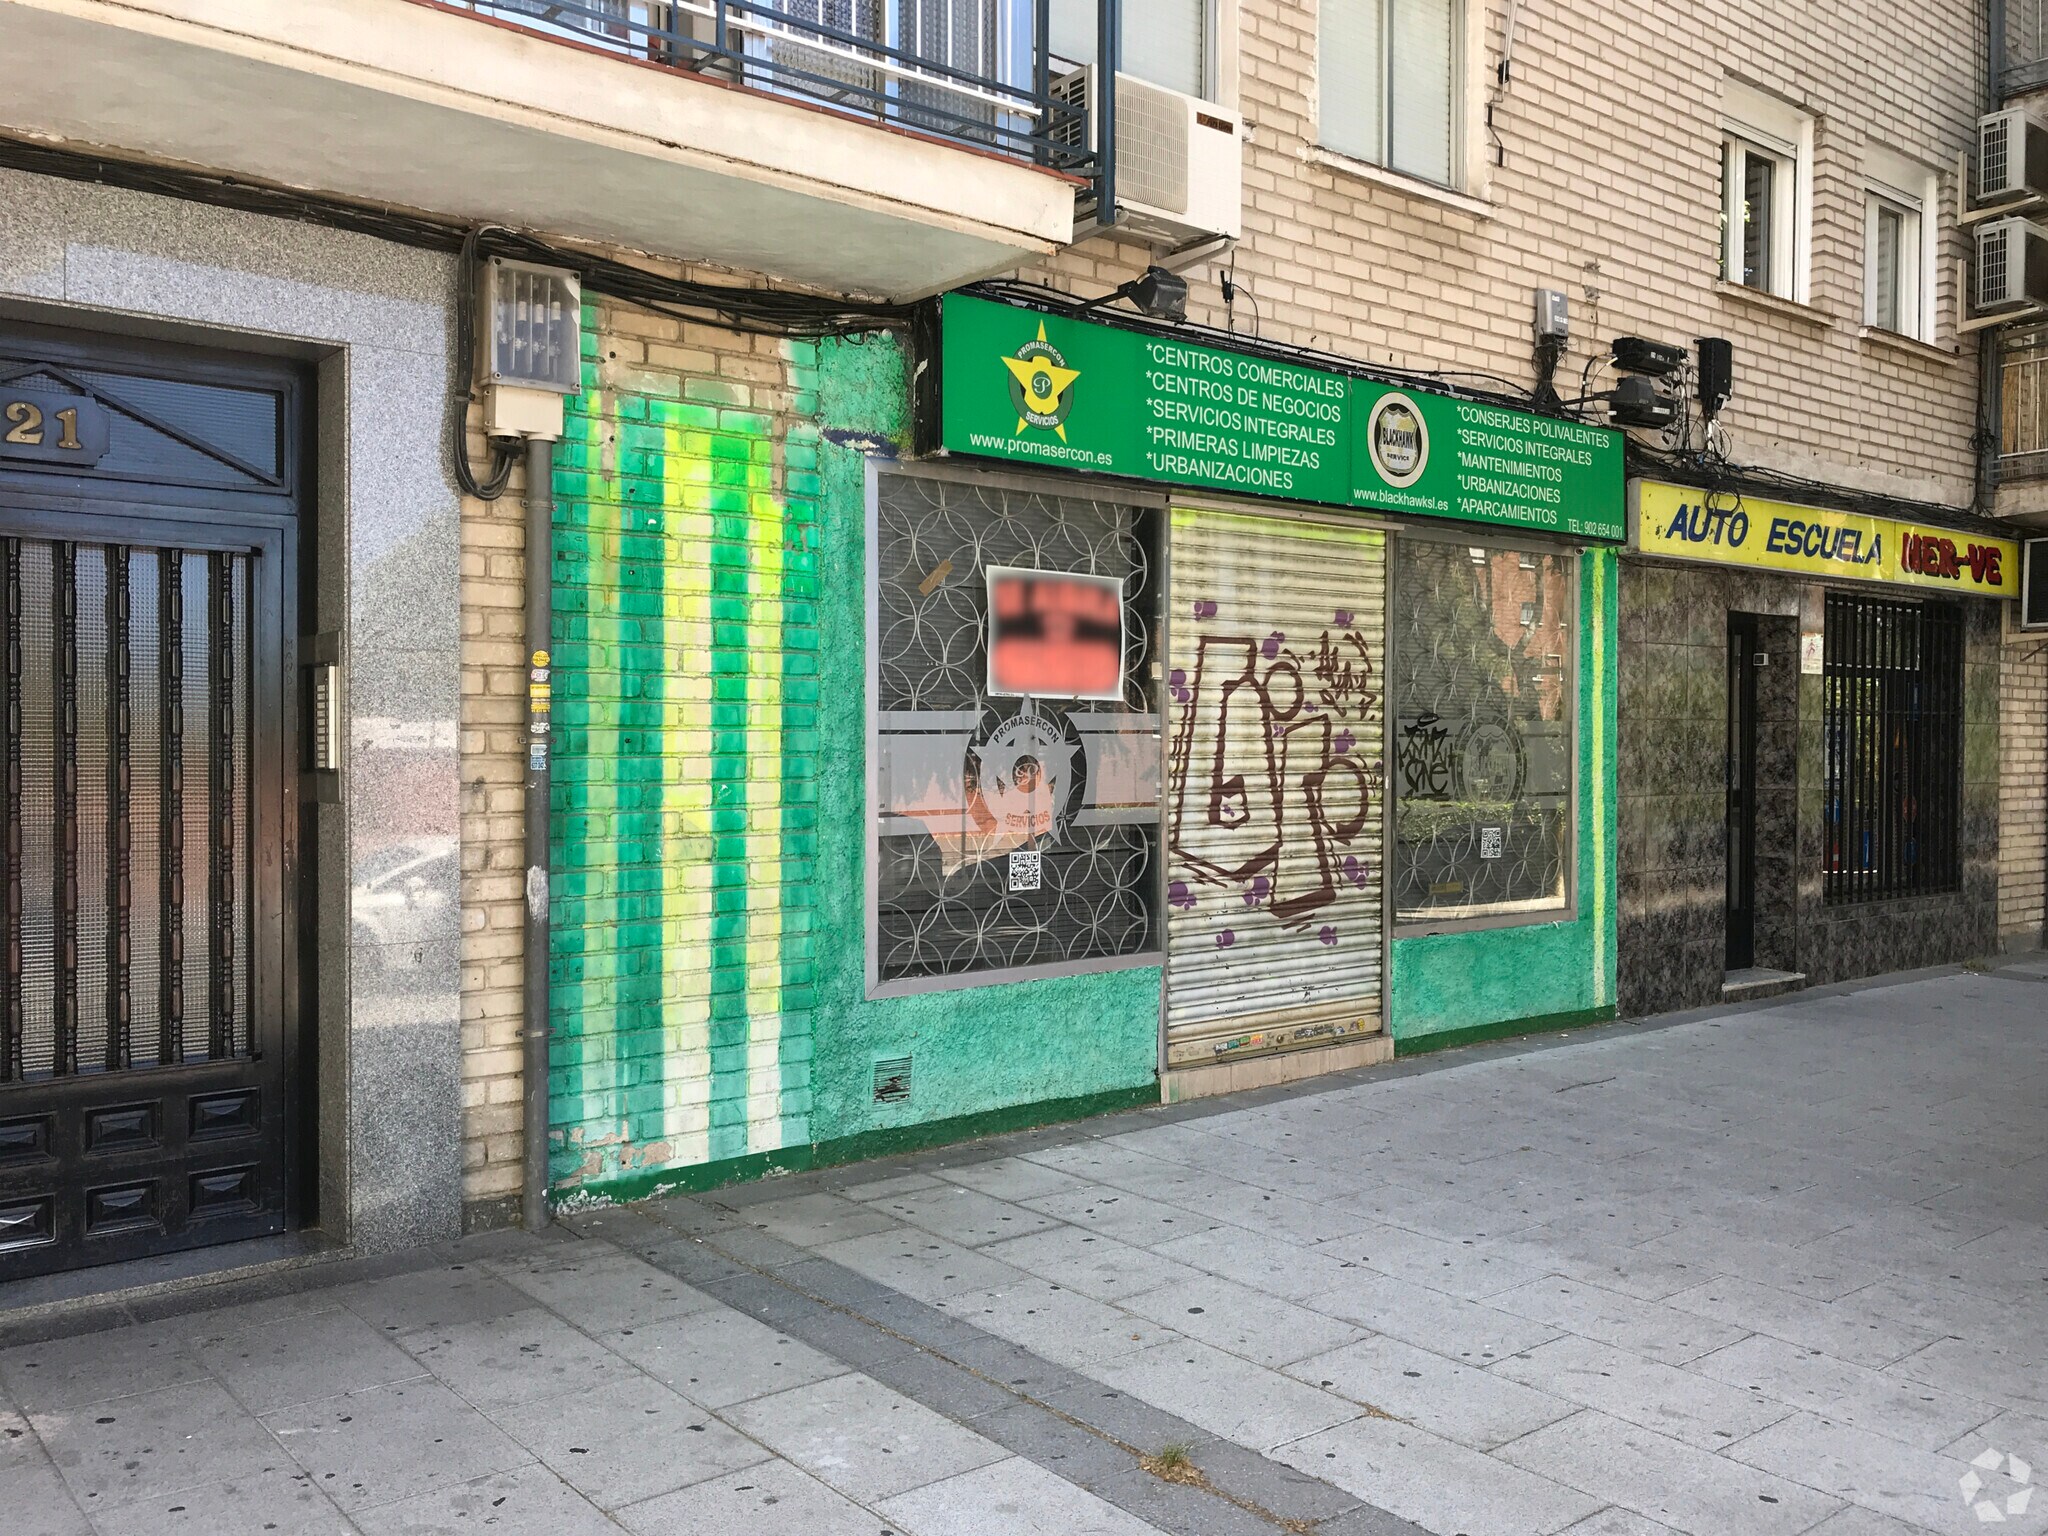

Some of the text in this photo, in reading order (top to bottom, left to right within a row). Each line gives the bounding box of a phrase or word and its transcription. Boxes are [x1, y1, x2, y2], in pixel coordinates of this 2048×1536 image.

[1018, 341, 1065, 367] PROMASERCON
[1237, 361, 1344, 398] COMERCIALES
[1026, 411, 1059, 425] SERVICIOS
[1237, 387, 1258, 408] DE
[1262, 392, 1341, 422] NEGOCIOS
[6, 402, 82, 449] 21
[1244, 415, 1335, 446] INTEGRALES
[1533, 421, 1609, 449] POLIVALENTES
[970, 433, 1112, 465] www.promasercon.es
[1242, 440, 1320, 469] LIMPIEZAS
[1386, 453, 1410, 462] SERVICE
[1525, 442, 1592, 466] INTEGRALES
[1353, 488, 1448, 511] www.blackhawksl.es
[1568, 518, 1623, 538] TEL: 902 654 001
[1666, 503, 1748, 547] AUTO
[1766, 518, 1881, 565] ESCUELA
[993, 714, 1059, 744] PROMASERCON
[1004, 810, 1050, 828] SERVICIOS
